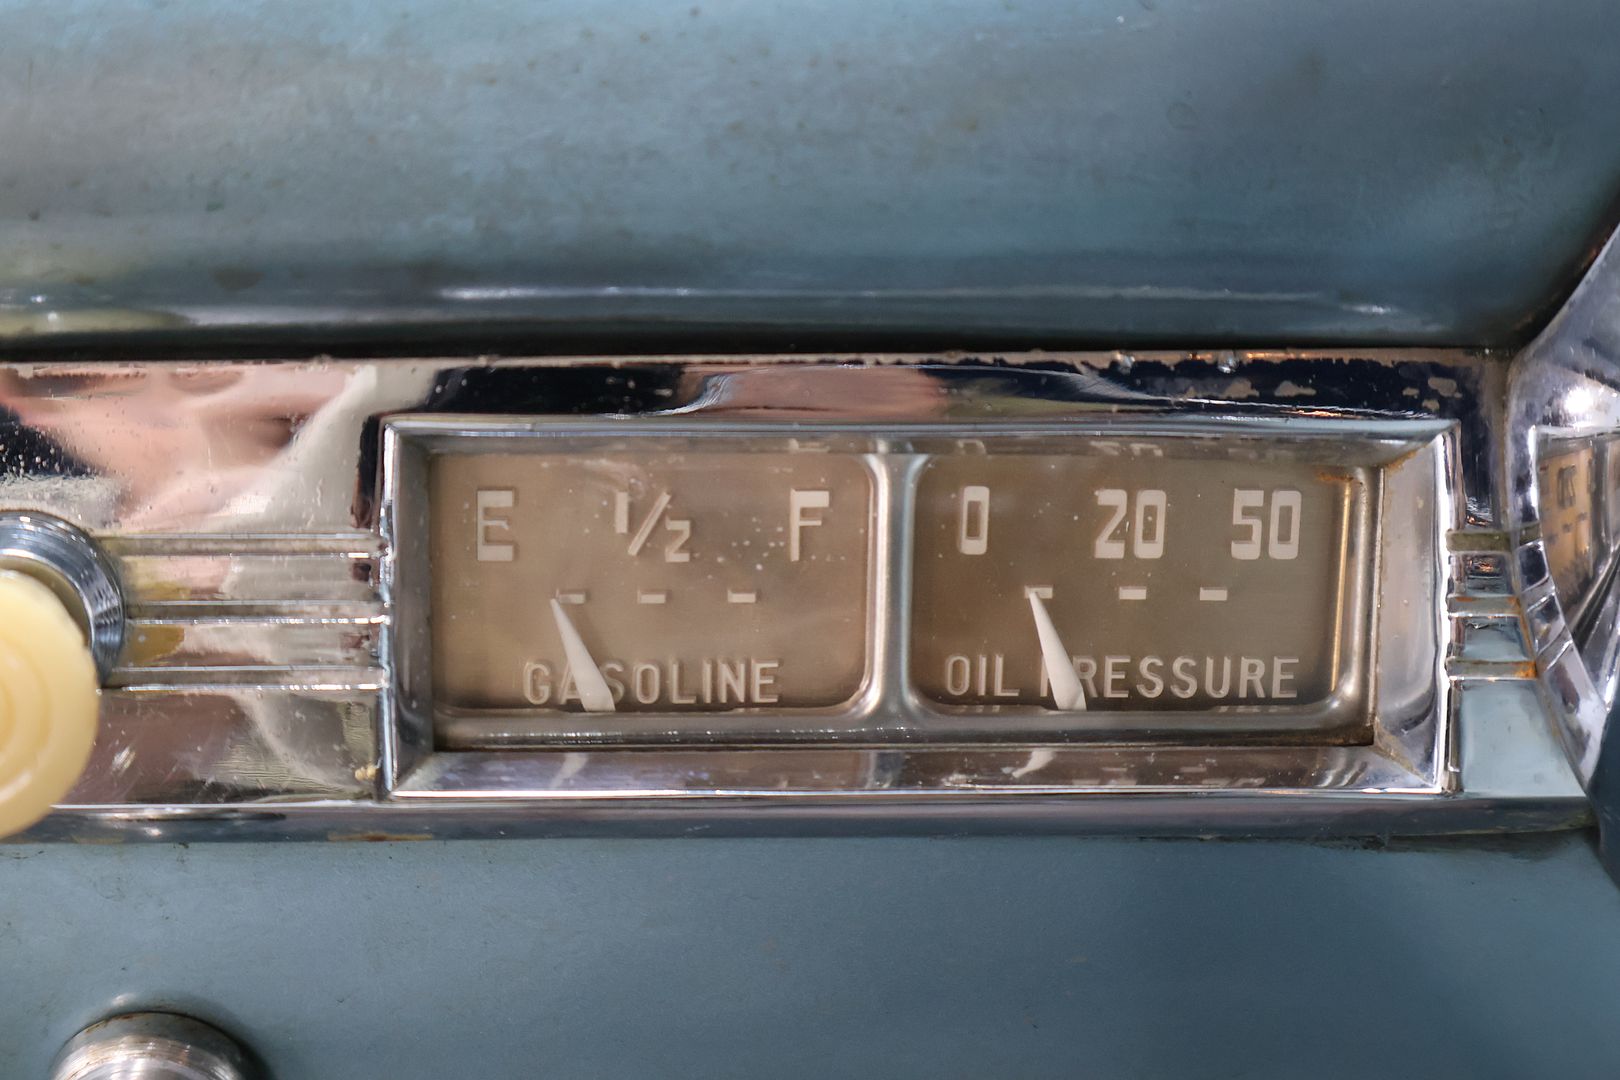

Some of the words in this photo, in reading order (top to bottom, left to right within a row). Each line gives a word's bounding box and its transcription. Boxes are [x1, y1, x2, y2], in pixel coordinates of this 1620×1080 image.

[477, 489, 514, 561] E
[614, 491, 691, 563] 1/2
[790, 488, 830, 562] F
[959, 486, 990, 555] 0
[1093, 489, 1167, 559] 20
[1230, 488, 1302, 560] 50
[945, 654, 1020, 697] OIL
